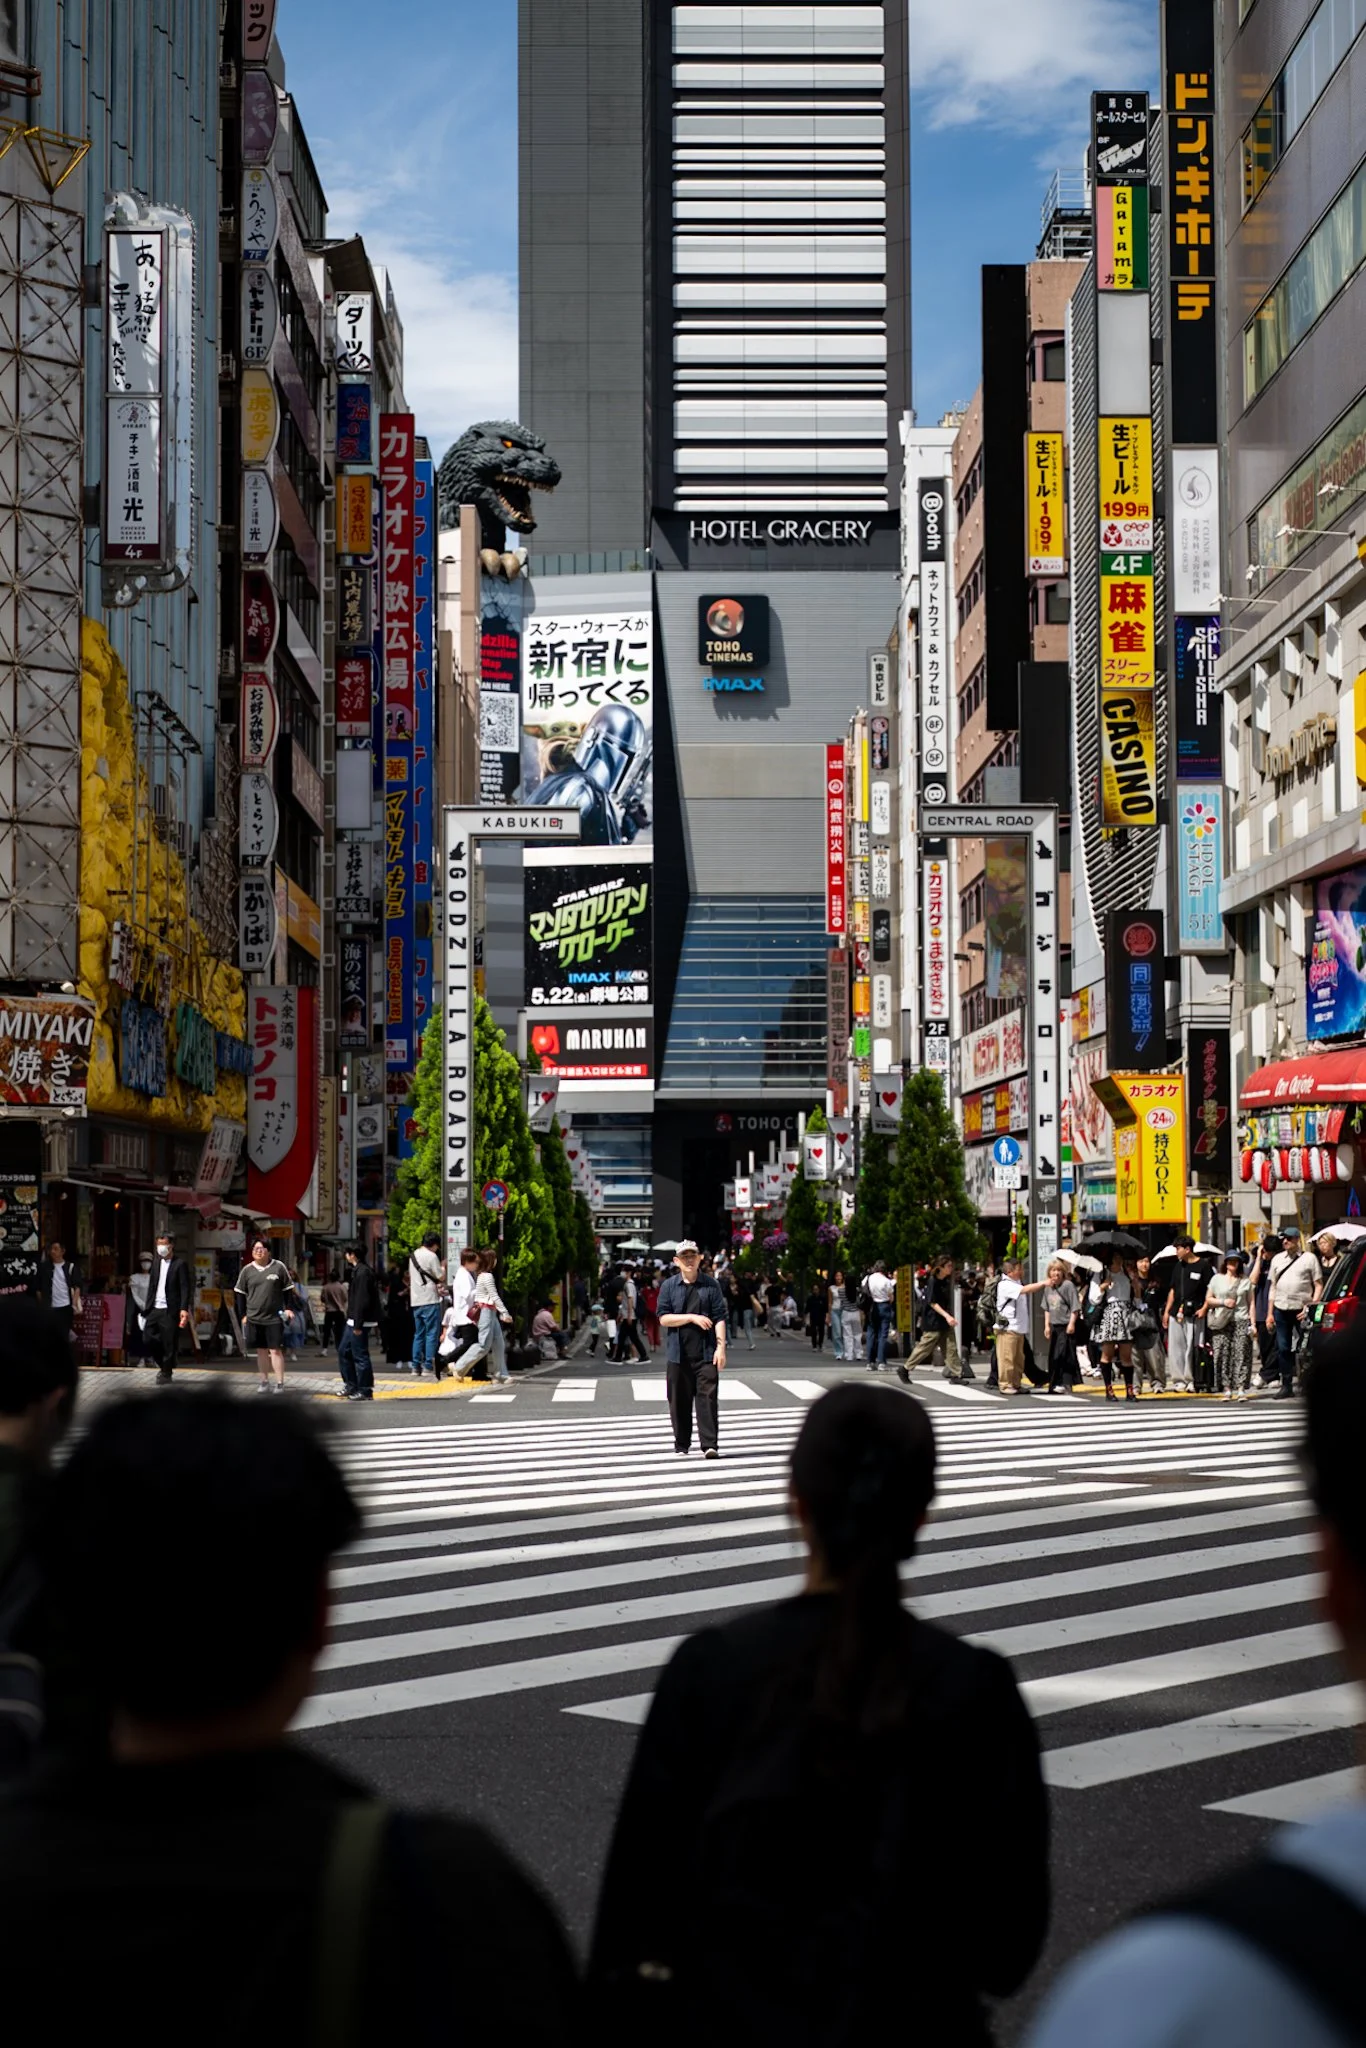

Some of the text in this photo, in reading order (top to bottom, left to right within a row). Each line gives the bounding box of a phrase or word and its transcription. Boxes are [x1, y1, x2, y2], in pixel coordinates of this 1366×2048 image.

[1115, 178, 1130, 186] 7F
[1174, 72, 1211, 321] ドン・キホーテ
[248, 250, 262, 259] 7F
[1104, 274, 1142, 285] ガラム
[345, 306, 363, 357] ダーツ
[245, 345, 267, 358] 6F
[128, 433, 140, 493] チキン酒場
[1035, 440, 1051, 498] 生ビール
[1112, 424, 1131, 495] 生ビール
[123, 497, 144, 522] 光
[1103, 502, 1149, 517] 199円
[249, 527, 261, 541] 光
[690, 519, 872, 539] HOTEL GRACERY
[1039, 501, 1052, 552] 199円
[125, 545, 143, 559] 4F
[381, 425, 409, 690] カラオケ歌広場
[1110, 555, 1143, 575] 4F
[928, 569, 940, 638] ネットカフェ
[530, 617, 650, 636] スター・ウォーズが
[1108, 581, 1147, 653] 麻雀
[528, 637, 650, 680] 新宿に
[706, 641, 741, 652] TOHO
[706, 652, 754, 662] CINEMAS
[928, 644, 939, 654] &
[1104, 658, 1141, 670] スリー
[528, 679, 650, 710] 帰ってくる
[703, 677, 765, 691] IMAX
[875, 663, 885, 702] 東京ビル
[1103, 697, 1154, 816] CASINO
[928, 816, 1034, 827] CENTRAL ROAD
[246, 855, 262, 866] 1F
[1188, 843, 1201, 897] STAGE
[1202, 843, 1214, 888] IDOL
[552, 877, 625, 908] STAR WARS
[529, 882, 649, 943] マンダロリアン
[1188, 914, 1214, 931] 5F
[387, 936, 404, 970] Shop
[538, 939, 559, 951] アンド
[557, 918, 635, 969] グローグー
[929, 874, 944, 1016] カラオケ まねきねこ
[246, 952, 262, 963] B1
[387, 972, 404, 1001] Free
[568, 972, 611, 984] IMAX
[280, 989, 294, 1051] 大衆酒場
[387, 1001, 404, 1025] Tax
[448, 867, 467, 1149] GODZILLA ROAD
[1035, 890, 1054, 1128] ゴジラロード
[0, 1010, 94, 1047] MIYAKI
[566, 1027, 647, 1051] MARUHAN
[928, 1023, 946, 1035] 2F
[254, 997, 278, 1101] トラノコ
[1129, 1084, 1180, 1097] カラオケ
[738, 1116, 781, 1130] TOHO
